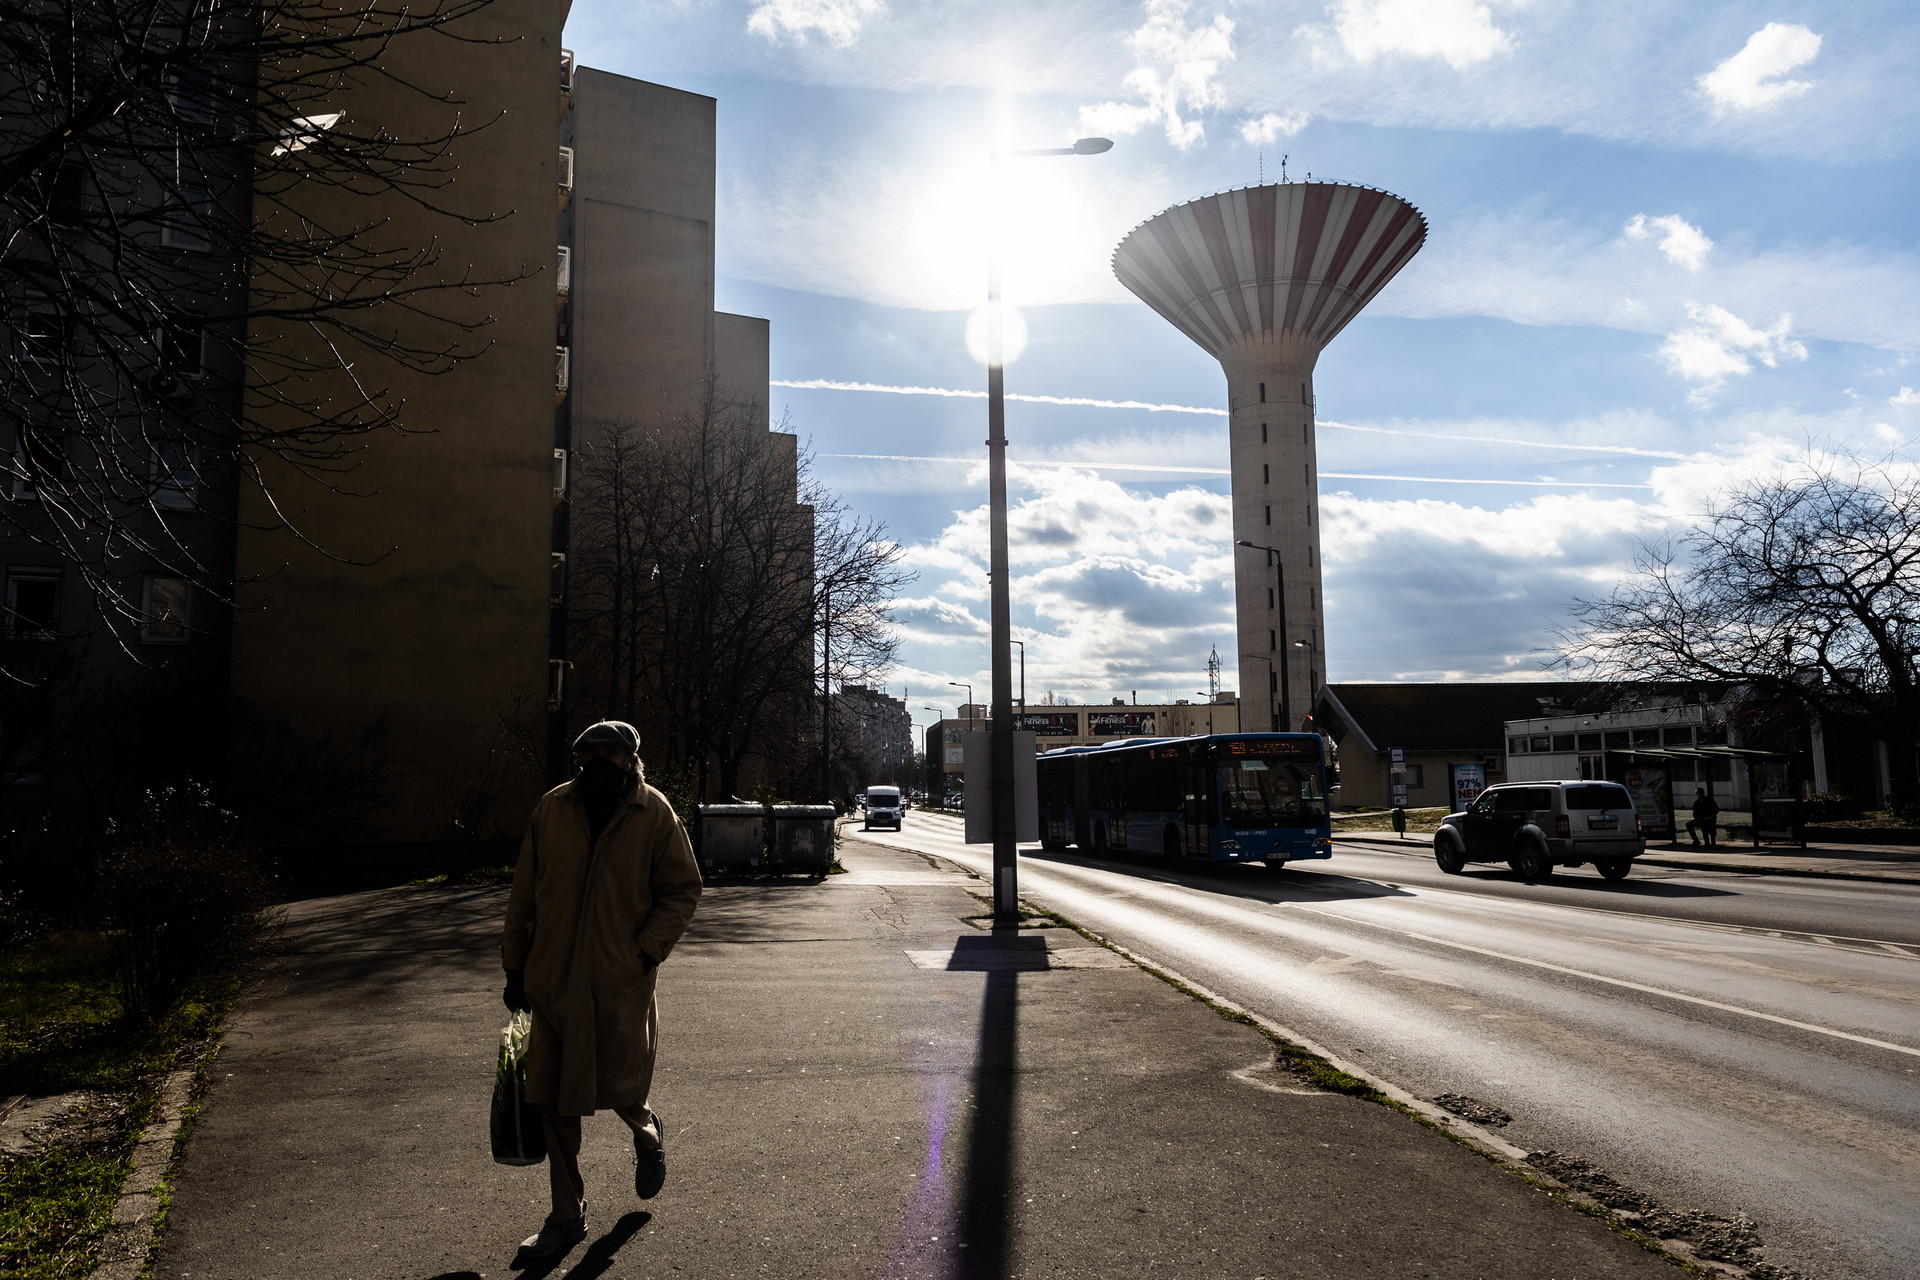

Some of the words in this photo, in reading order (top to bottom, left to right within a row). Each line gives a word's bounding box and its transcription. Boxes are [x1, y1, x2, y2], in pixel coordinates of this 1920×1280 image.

[1024, 717, 1049, 725] Fitness
[1457, 778, 1481, 789] 97%
[1458, 788, 1482, 799] NEM
